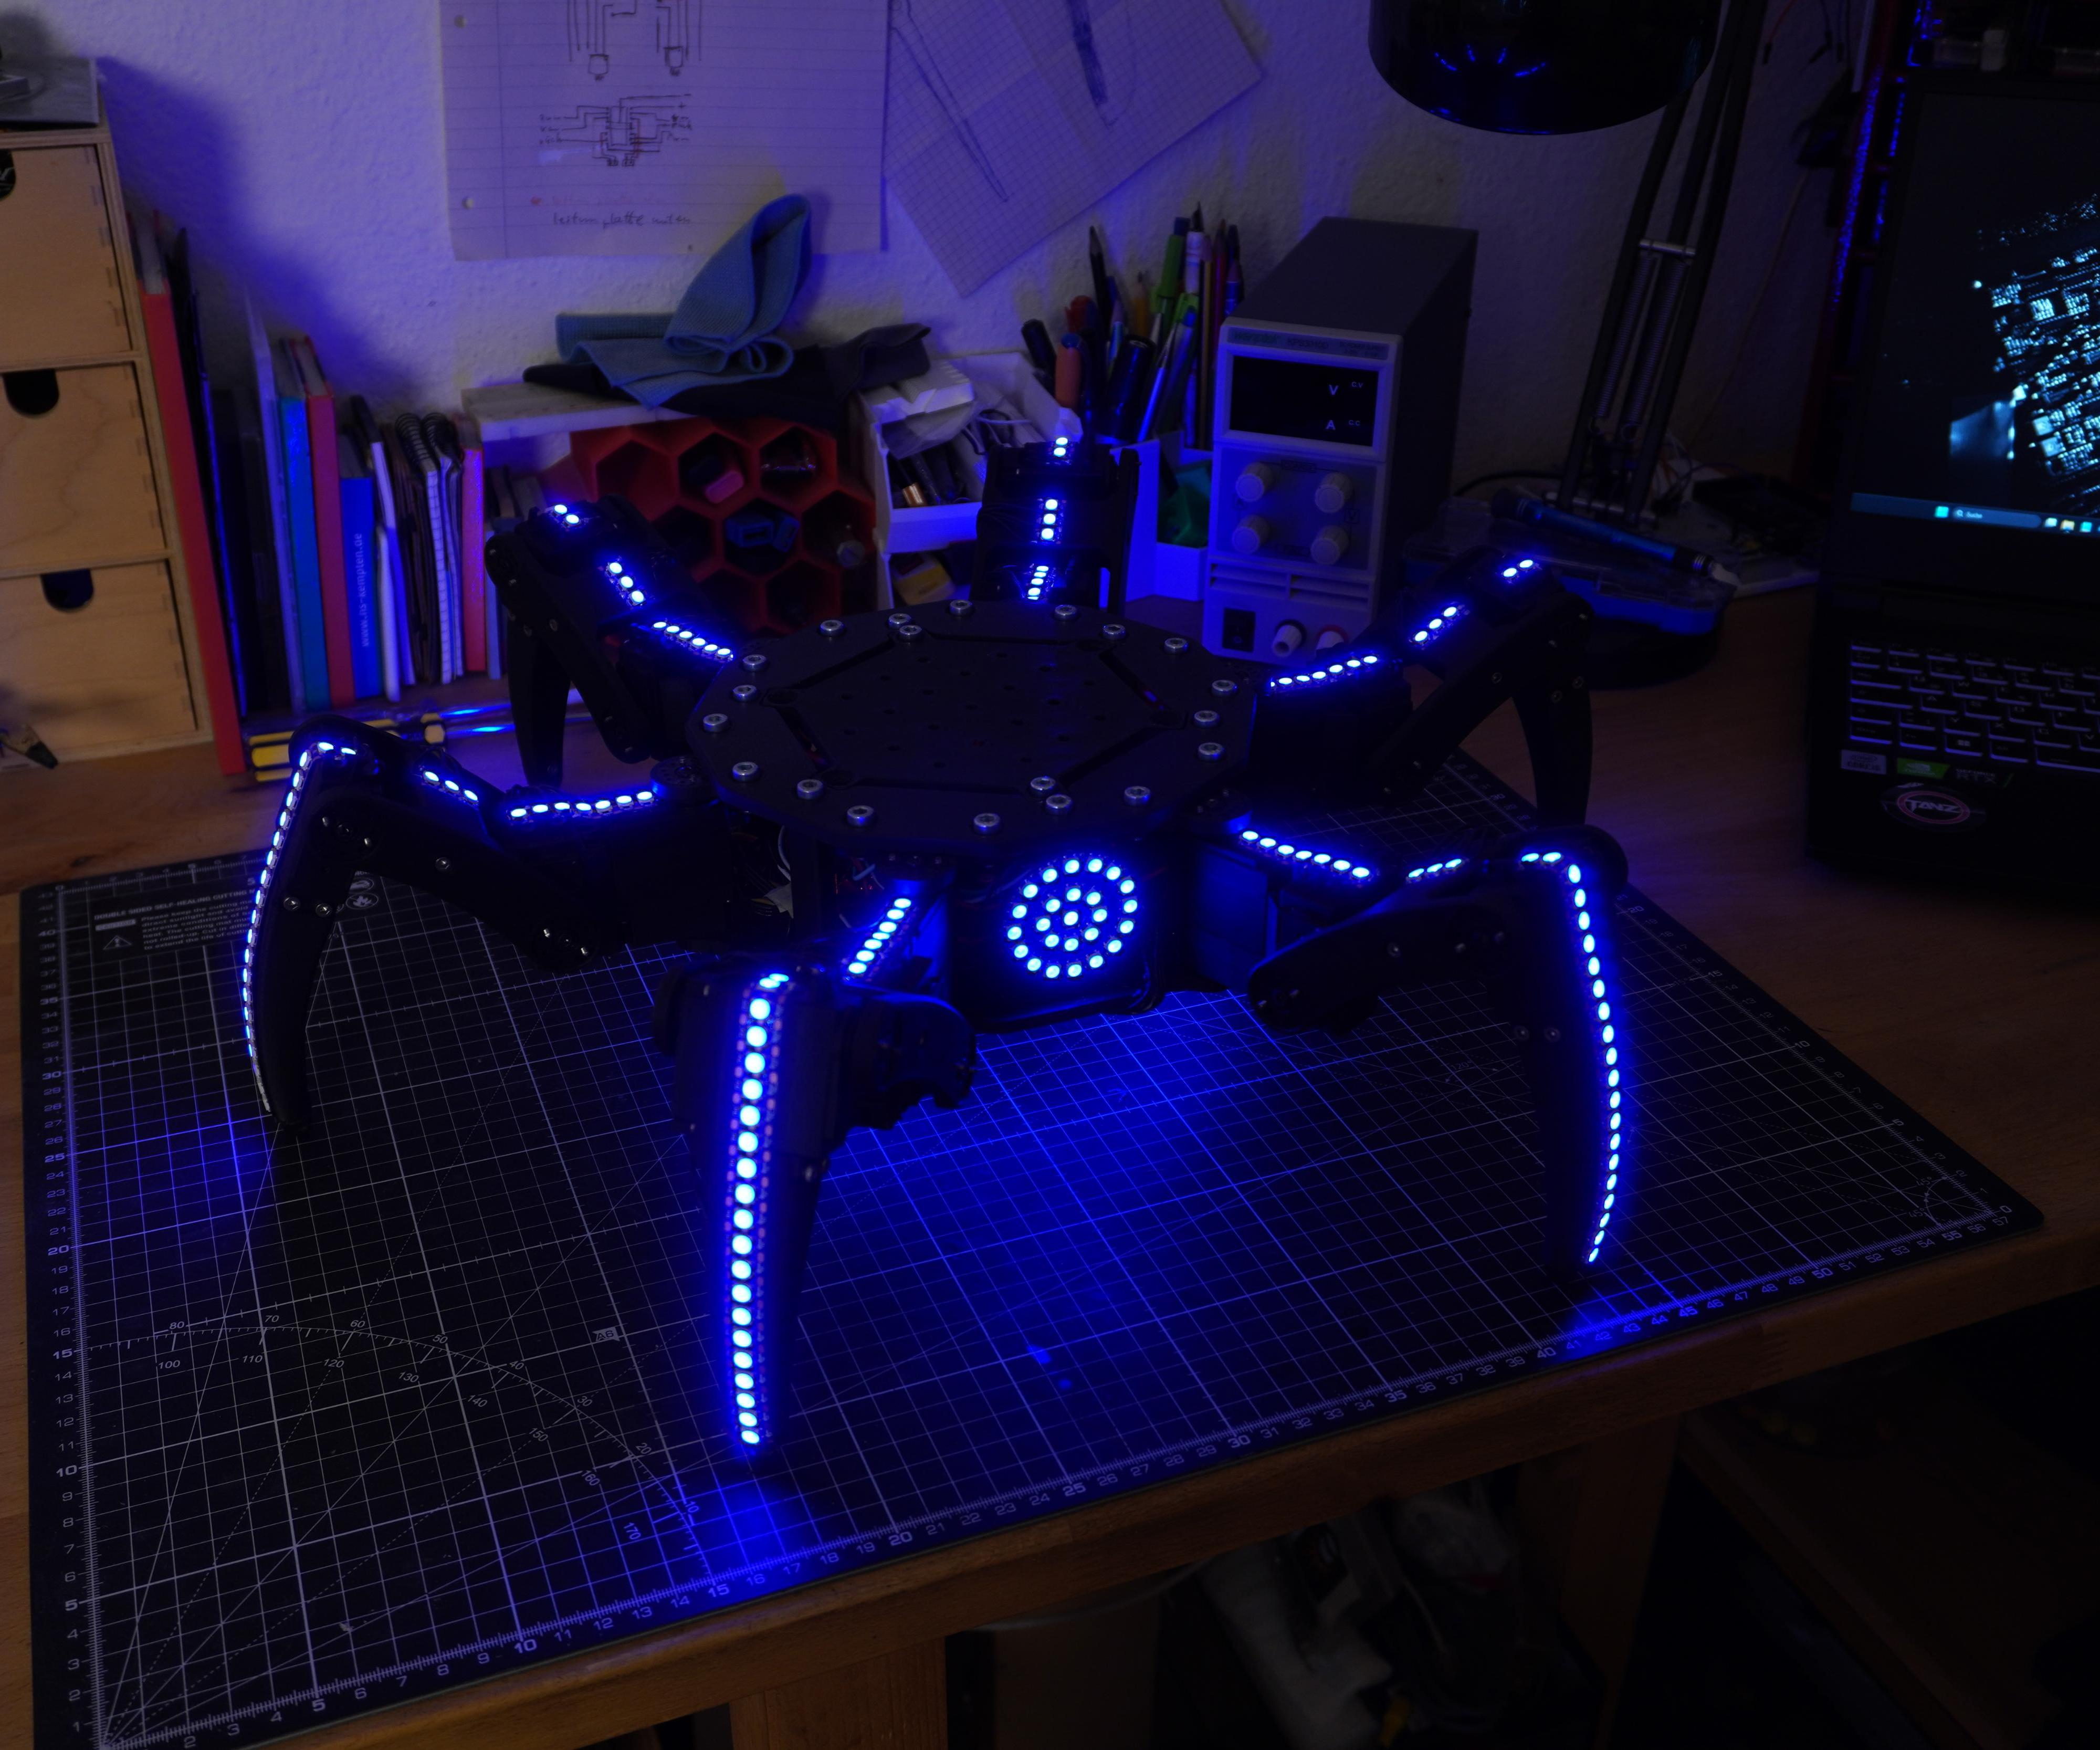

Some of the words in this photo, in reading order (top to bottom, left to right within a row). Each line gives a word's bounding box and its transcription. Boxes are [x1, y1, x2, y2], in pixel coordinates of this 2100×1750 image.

[1328, 384, 1339, 395] V
[1326, 420, 1336, 431] A
[94, 910, 127, 920] DOUBLE
[128, 906, 152, 914] SIDED
[154, 896, 211, 910] SELF-HEALING
[213, 890, 247, 900] CUTTING
[170, 913, 204, 923] sunlight
[142, 924, 177, 933] extreme
[181, 915, 228, 927] conditions
[184, 923, 214, 932] cutting
[155, 940, 184, 948] extend
[1795, 1040, 1811, 1049] 10
[42, 1071, 61, 1080] 30
[44, 1119, 62, 1128] 27
[44, 1152, 65, 1162] 25
[46, 1171, 64, 1180] 24
[47, 1189, 66, 1198] 23
[47, 1207, 66, 1217] 22
[49, 1226, 66, 1235] 21
[47, 1244, 69, 1256] 20
[51, 1265, 68, 1275] 19
[51, 1285, 68, 1295] 18
[52, 1306, 70, 1316] 17
[264, 1315, 279, 1323] 70
[350, 1319, 365, 1328] 60
[169, 1321, 184, 1329] 80
[53, 1327, 71, 1337] 16
[597, 1330, 614, 1340] A6
[432, 1334, 448, 1344] 50
[52, 1349, 73, 1359] 15
[158, 1360, 181, 1369] 100
[243, 1355, 262, 1364] 110
[323, 1358, 344, 1368] 120
[509, 1360, 524, 1370] 40
[55, 1371, 72, 1381] 14
[398, 1371, 419, 1382] 130
[55, 1394, 73, 1404] 13
[467, 1395, 488, 1407] 140
[577, 1396, 593, 1407] 30
[56, 1417, 74, 1428] 12
[529, 1428, 548, 1441] 150
[59, 1441, 74, 1452] 11
[635, 1442, 652, 1454] 20
[56, 1464, 77, 1477] 10
[183, 1735, 197, 1749] 2
[226, 1723, 240, 1736] 3
[270, 1711, 282, 1722] 4
[312, 1699, 326, 1712] 5
[354, 1687, 367, 1699] 6
[395, 1675, 407, 1688] 7
[437, 1664, 449, 1675] 8
[477, 1652, 490, 1664] 9
[514, 1639, 538, 1654] 10
[554, 1629, 572, 1642] 11
[593, 1617, 614, 1631] 12
[632, 1606, 653, 1619] 13
[670, 1595, 690, 1608] 14
[708, 1584, 730, 1598] 15
[746, 1573, 766, 1586] 16
[782, 1562, 801, 1575] 17
[820, 1552, 839, 1565] 18
[856, 1542, 876, 1554] 19
[888, 1531, 913, 1547] 20
[925, 1522, 946, 1536] 21
[959, 1512, 982, 1526] 22
[994, 1502, 1017, 1516] 23
[1029, 1493, 1051, 1506] 24
[1062, 1481, 1086, 1497] 25
[1097, 1473, 1118, 1486] 26
[1130, 1463, 1150, 1477] 27
[1163, 1454, 1184, 1467] 28
[1196, 1444, 1217, 1458] 29
[1227, 1434, 1251, 1449] 30
[1260, 1426, 1280, 1439] 31
[1292, 1416, 1314, 1430] 32
[1323, 1408, 1345, 1420] 33
[1354, 1398, 1375, 1411] 34
[1384, 1389, 1407, 1403] 35
[1415, 1381, 1436, 1394] 36
[1446, 1372, 1463, 1385] 37
[1476, 1364, 1496, 1376] 38
[1505, 1356, 1526, 1367] 39
[1537, 1346, 1557, 1359] 40
[1566, 1339, 1582, 1350] 41
[1595, 1331, 1612, 1341] 42
[1623, 1323, 1641, 1333] 43
[1652, 1315, 1668, 1325] 44
[1679, 1306, 1698, 1317] 45
[1707, 1298, 1725, 1309] 46
[1734, 1291, 1748, 1301] 47
[1761, 1283, 1779, 1293] 48
[1789, 1276, 1805, 1285] 49
[1812, 1267, 1834, 1279] 50
[1838, 1261, 1856, 1270] 51
[1865, 1253, 1885, 1263] 52
[1891, 1245, 1910, 1255] 53
[1916, 1239, 1936, 1248] 54
[1942, 1230, 1962, 1241] 55
[1968, 1223, 1986, 1233] 56
[1992, 1216, 2008, 1225] 57
[581, 1470, 601, 1486] 160
[62, 1491, 72, 1502] 9
[685, 1501, 699, 1513] 10
[62, 1517, 74, 1528] 8
[624, 1522, 642, 1540] 170
[63, 1544, 75, 1554] 7
[64, 1571, 76, 1582] 6
[65, 1598, 78, 1611] 5
[66, 1628, 78, 1639] 4
[67, 1658, 79, 1670] 3
[68, 1689, 80, 1701] 2
[74, 1721, 80, 1732] 1
